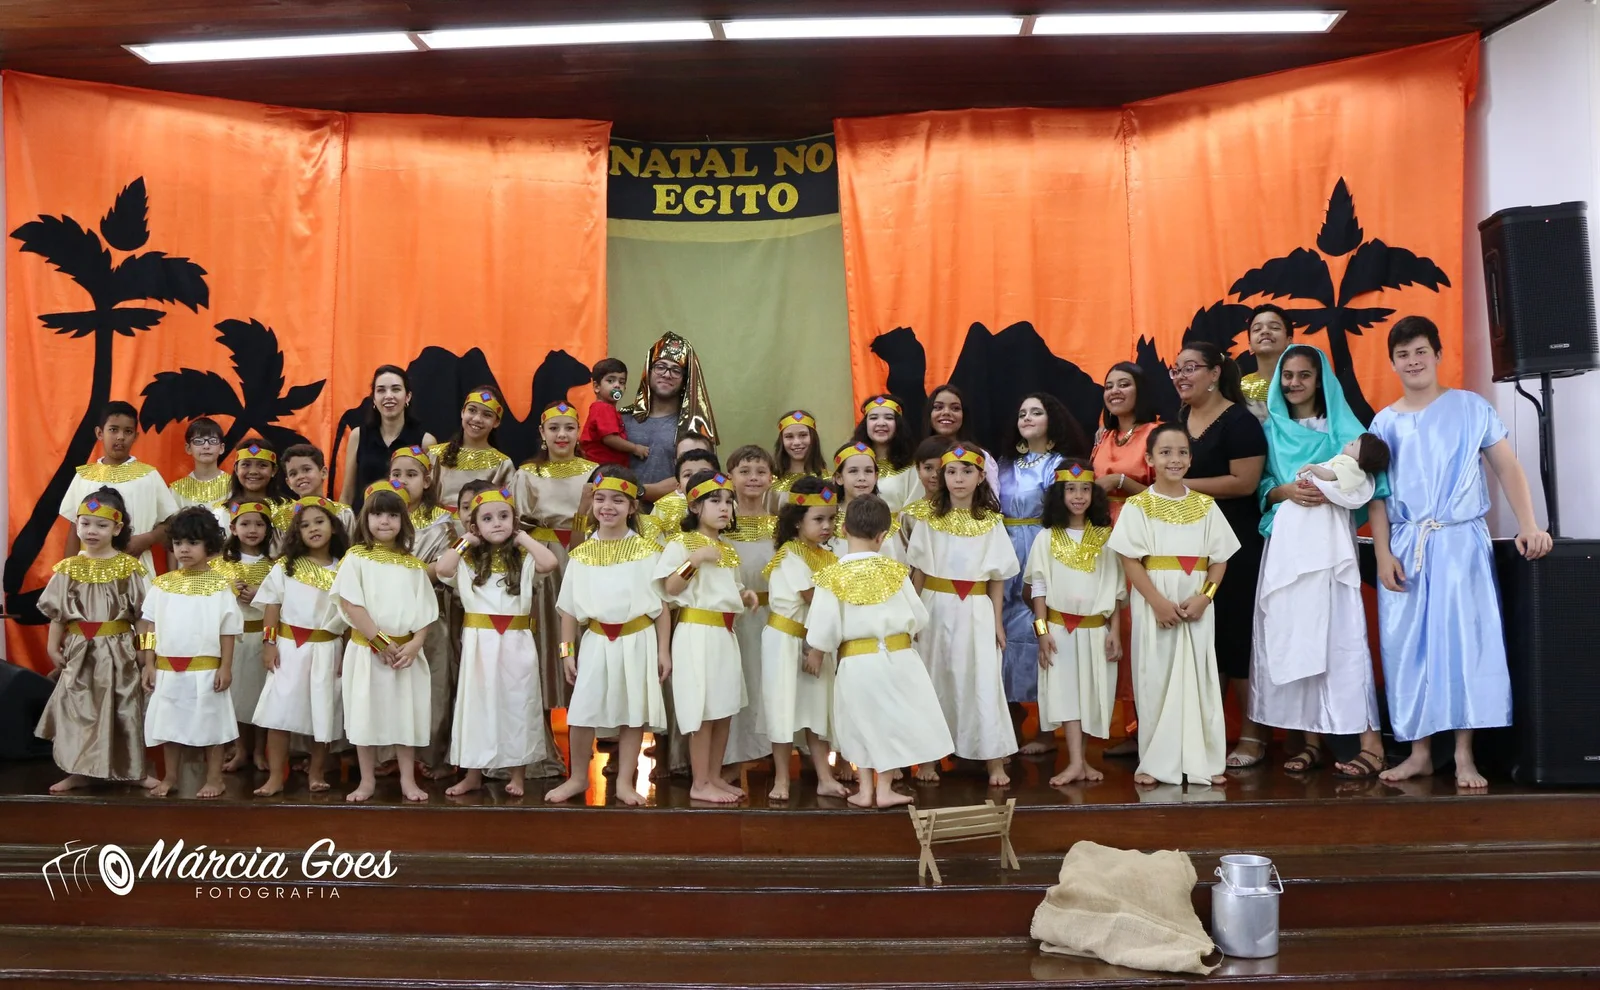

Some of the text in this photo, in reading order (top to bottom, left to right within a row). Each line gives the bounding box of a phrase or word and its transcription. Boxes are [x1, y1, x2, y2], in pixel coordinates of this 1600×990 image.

[609, 142, 834, 178] NATAL NO
[652, 182, 799, 215] EGITO
